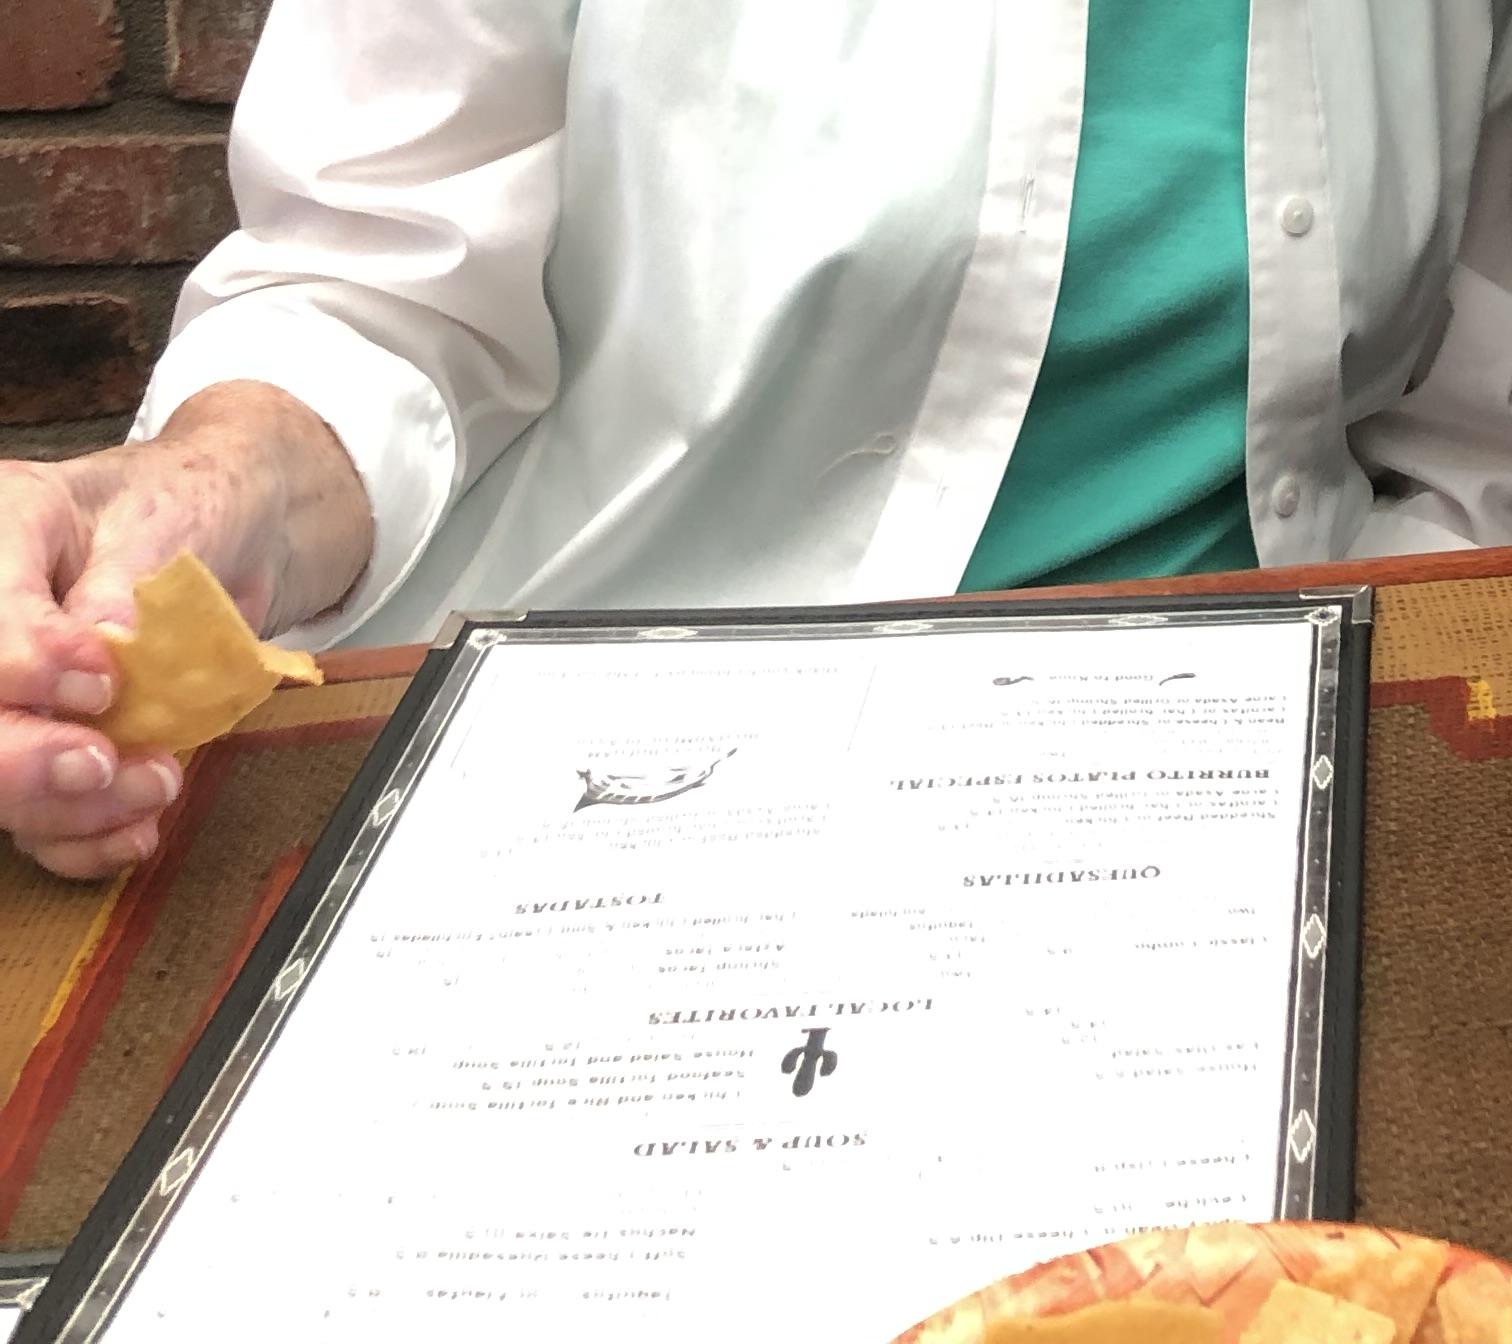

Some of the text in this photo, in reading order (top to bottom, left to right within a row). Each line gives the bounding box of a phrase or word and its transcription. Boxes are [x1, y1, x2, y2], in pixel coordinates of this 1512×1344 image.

[888, 768, 1271, 791] BURRITO PLATOS ESPECIAL
[961, 864, 1162, 889] QUESADILLAS
[512, 892, 664, 915] TOSTADAS
[645, 997, 935, 1028] LOCAL FAVORITES
[632, 1132, 868, 1157] SOUP & SALAD
